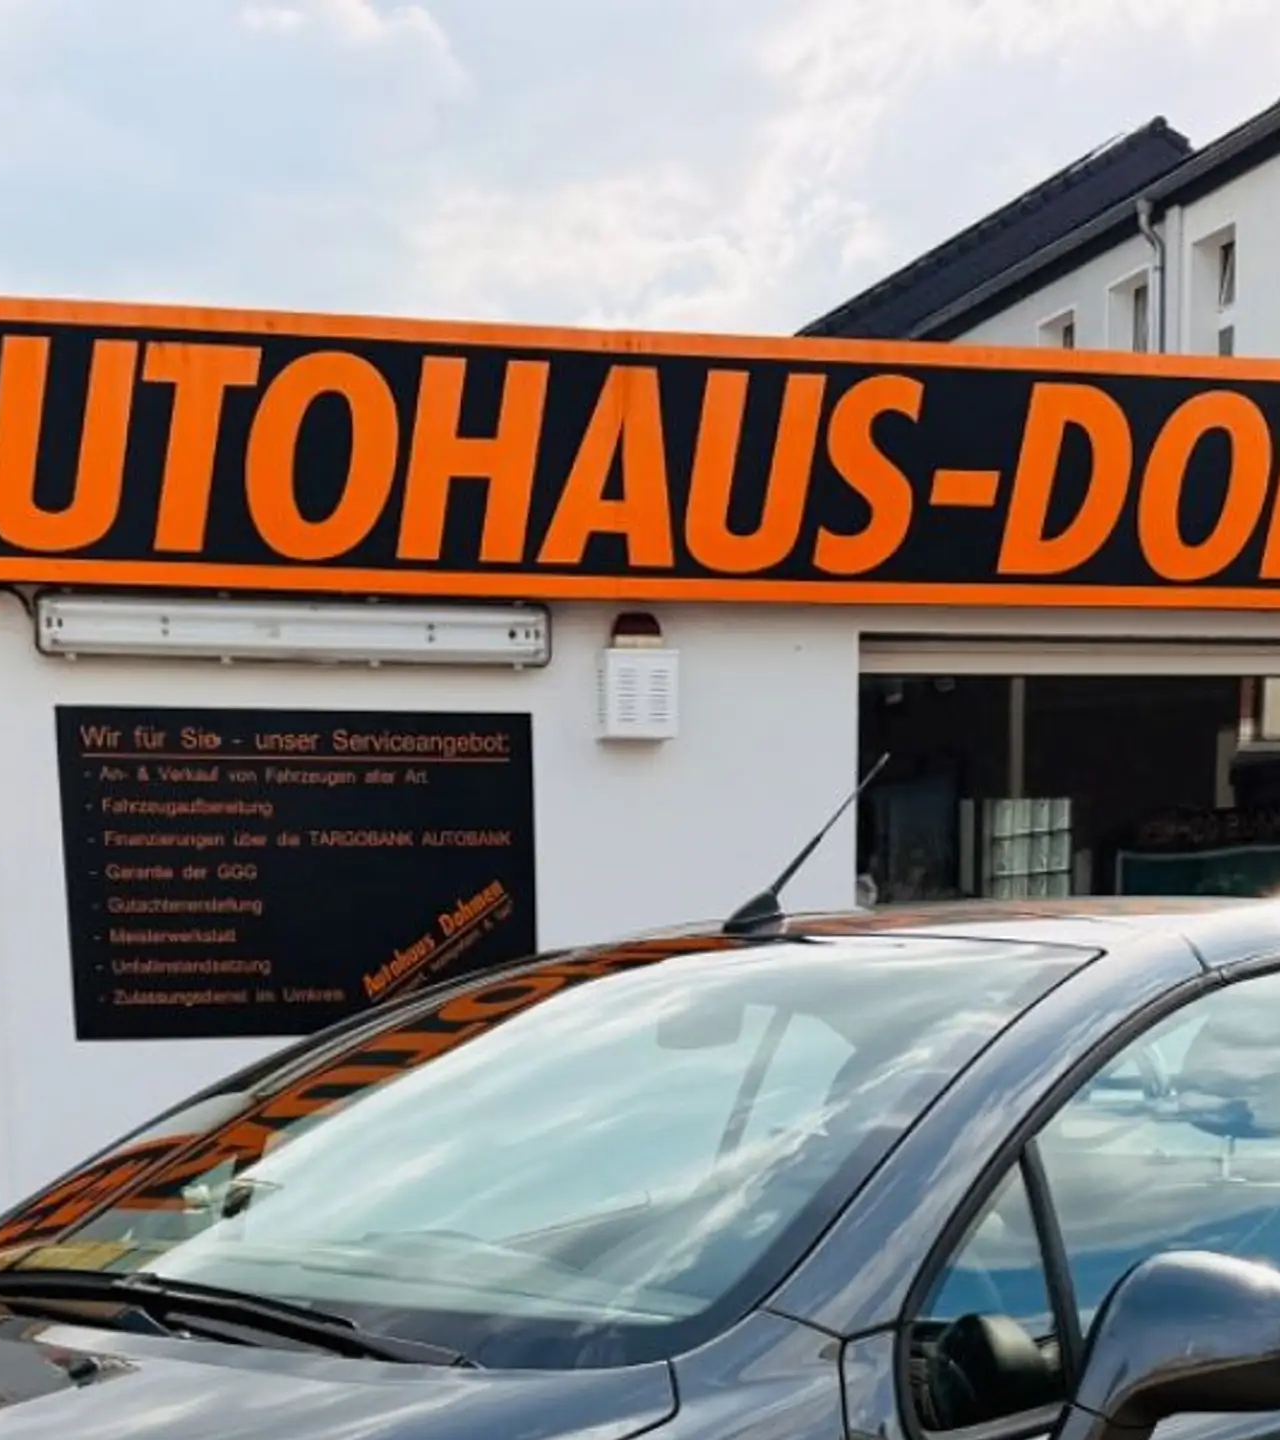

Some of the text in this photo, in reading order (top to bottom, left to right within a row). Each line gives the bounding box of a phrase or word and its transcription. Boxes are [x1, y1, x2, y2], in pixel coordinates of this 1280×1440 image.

[80, 724, 122, 749] Wir
[133, 725, 166, 749] für
[255, 731, 319, 751] unser
[158, 765, 219, 782] Verkauf
[228, 769, 257, 783] von
[265, 767, 356, 786] Fahrzeugen
[233, 830, 268, 846] über
[277, 830, 300, 846] die
[308, 830, 413, 847] TARGOBANK
[422, 830, 511, 847] AUTOBANK
[183, 863, 207, 880] der
[362, 932, 436, 997] Autohaus
[438, 879, 504, 937] Dohmen
[256, 988, 274, 1003] im
